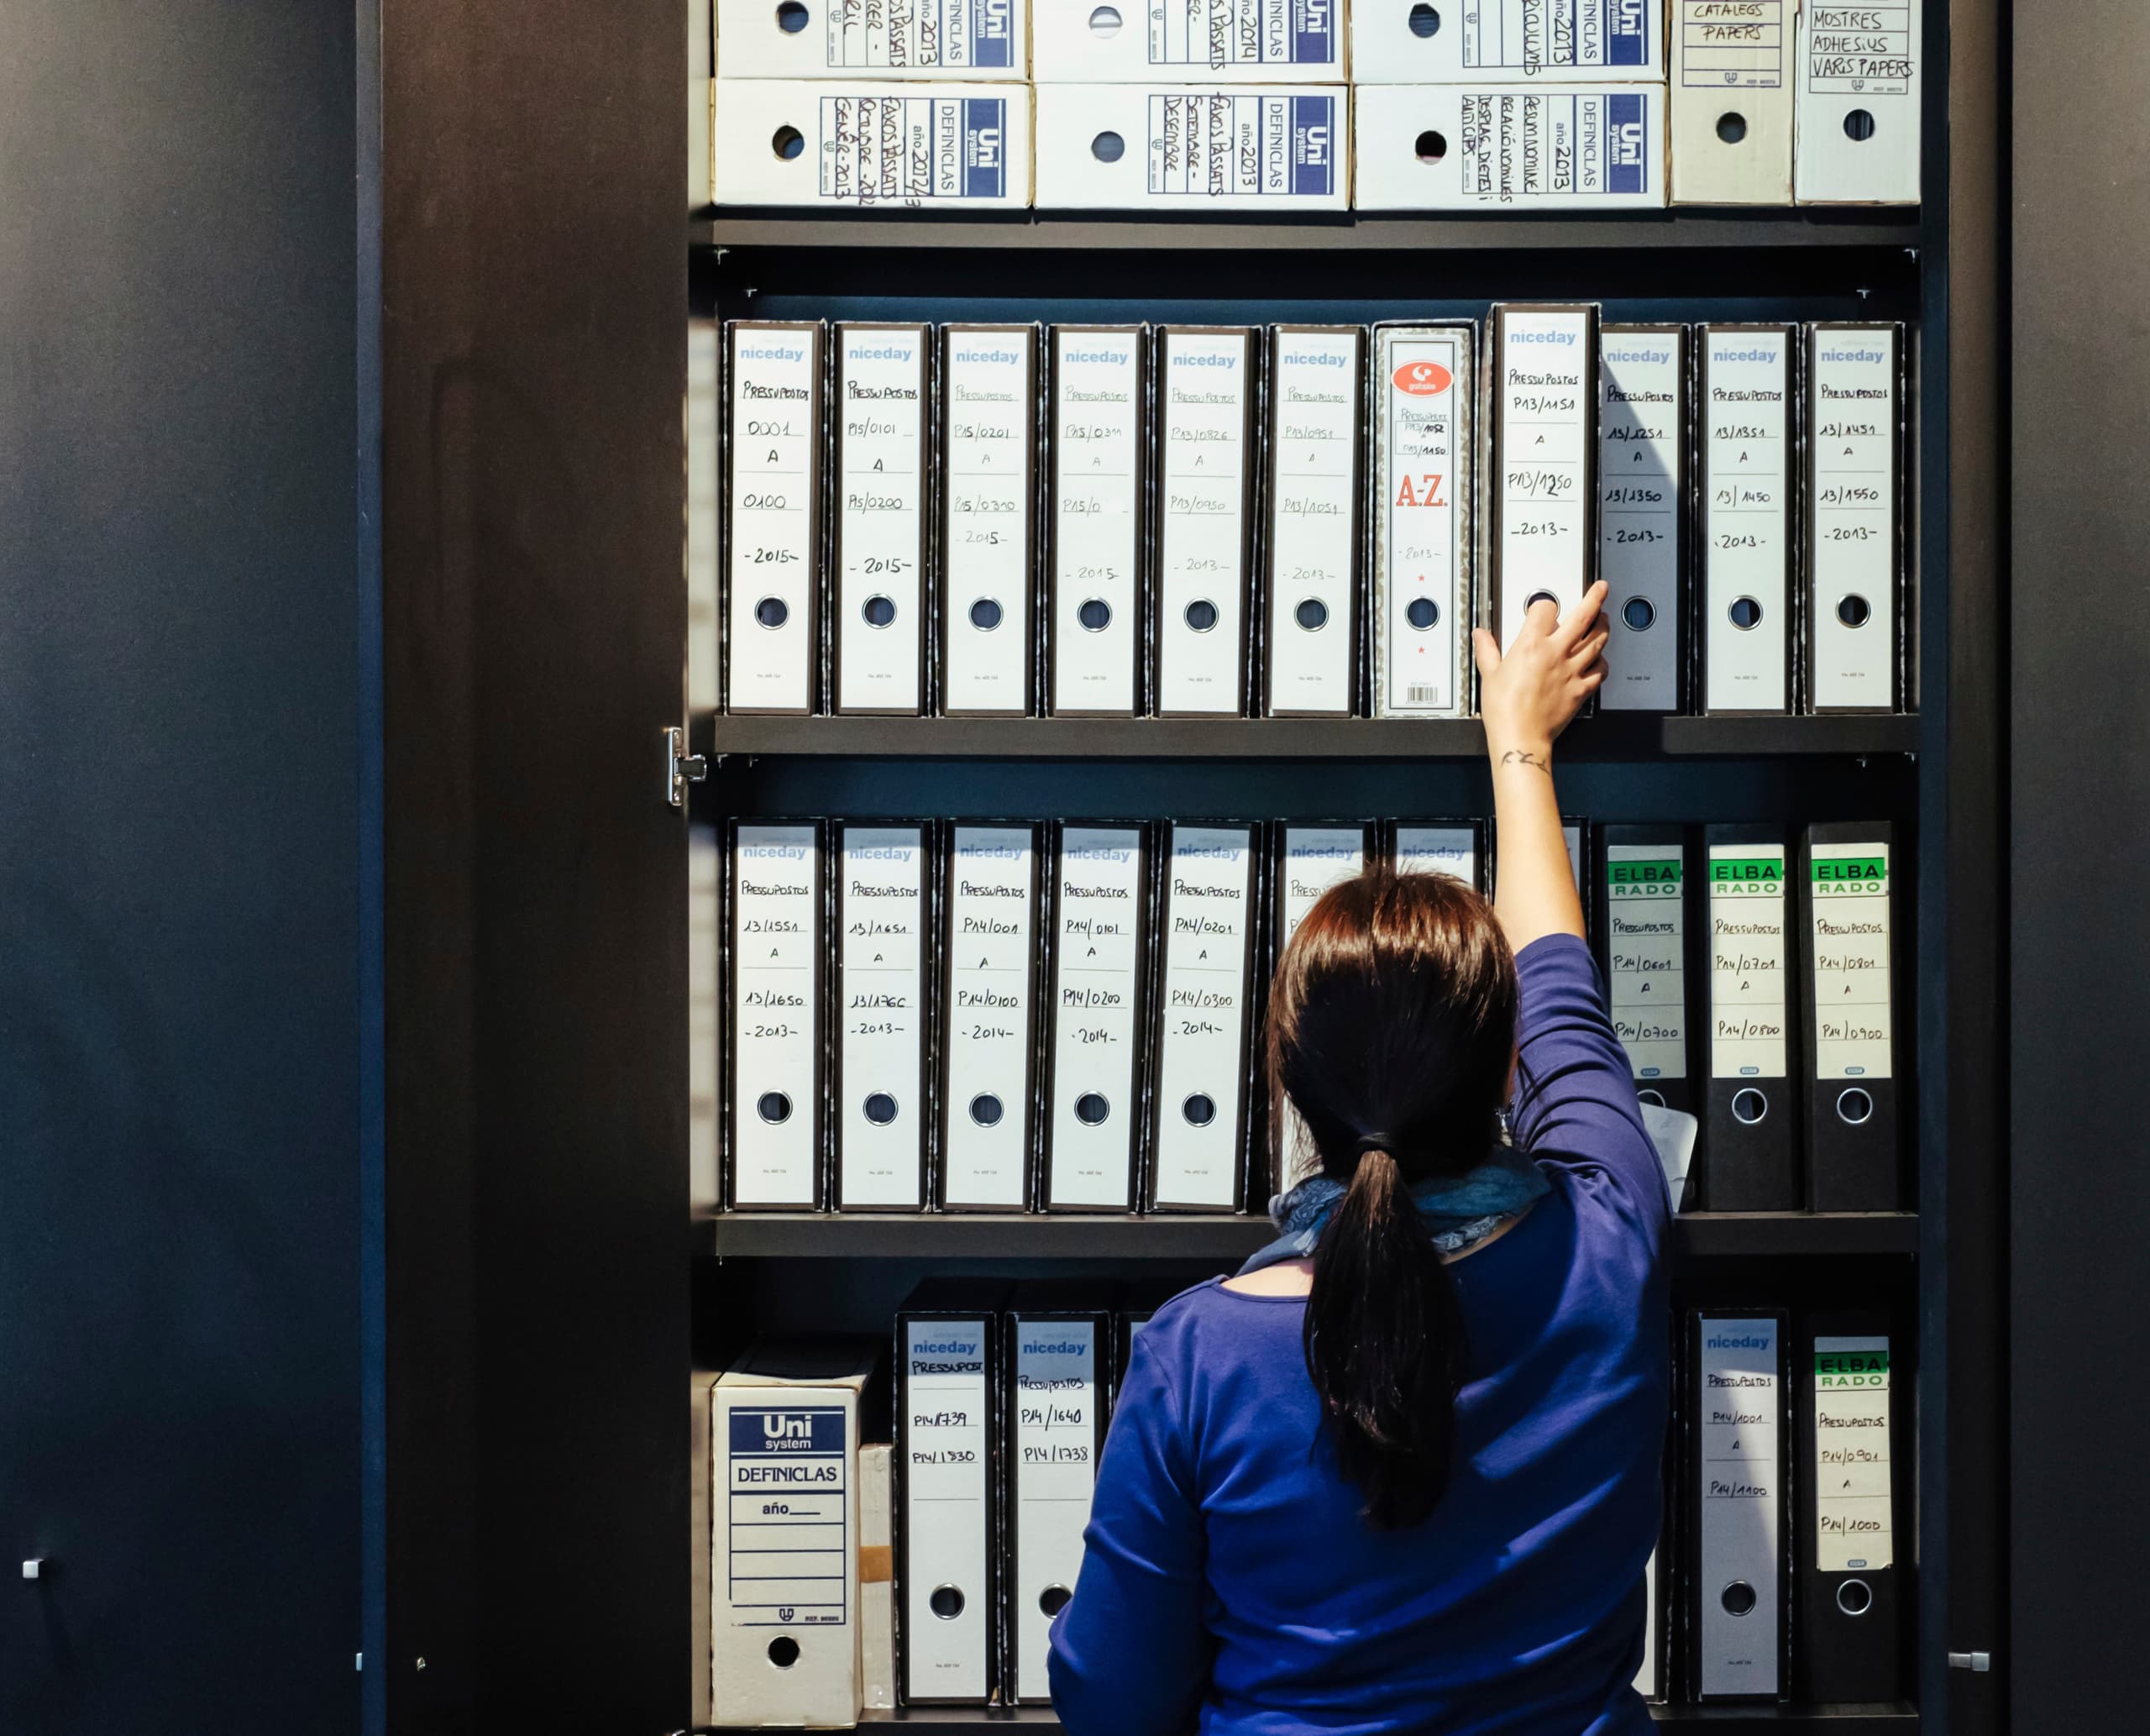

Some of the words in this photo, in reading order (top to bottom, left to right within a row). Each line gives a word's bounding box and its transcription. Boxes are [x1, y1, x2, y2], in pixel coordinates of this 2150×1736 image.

[1814, 11, 1883, 29] MOSTRES
[1241, 17, 1256, 58] 2014
[1701, 24, 1764, 40] PAPERS
[920, 20, 937, 65] 2013
[1554, 18, 1572, 64] 2013
[1859, 58, 1915, 77] PAPERS
[914, 125, 923, 149] año
[1242, 123, 1251, 145] año
[1555, 123, 1566, 145] año
[941, 106, 955, 190] DEFINICLAS
[968, 128, 978, 167] system
[978, 128, 999, 167] Uni
[1270, 103, 1282, 187] DEFINICLAS
[1297, 128, 1307, 164] system
[1308, 126, 1327, 165] Uni
[1584, 102, 1597, 186] DEFINICLAS
[1610, 125, 1620, 164] system
[1622, 123, 1641, 165] Uni
[1241, 146, 1256, 186] 2013
[1554, 145, 1571, 190] 2013
[1510, 329, 1576, 345] niceday
[740, 345, 804, 362] niceday
[849, 345, 912, 362] niceday
[956, 349, 1019, 365] niceday
[1065, 349, 1129, 365] niceday
[1173, 353, 1235, 369] niceday
[1284, 352, 1347, 368] niceday
[1607, 349, 1670, 365] niceday
[1713, 349, 1777, 365] niceday
[1821, 349, 1884, 365] niceday
[748, 421, 792, 436] 0001
[1535, 435, 1544, 444] A
[768, 449, 779, 464] A
[982, 454, 991, 464] A
[1633, 452, 1642, 462] A
[1739, 452, 1748, 463] A
[1843, 447, 1854, 456] A
[873, 459, 883, 473] A
[1092, 457, 1101, 466] A
[1195, 455, 1203, 466] A
[743, 494, 786, 509] 0100
[1606, 487, 1662, 503] 13/1350
[1820, 485, 1880, 505] 13/1550
[743, 844, 806, 861] niceday
[850, 844, 912, 862] niceday
[960, 843, 1022, 860] niceday
[1067, 845, 1130, 863] niceday
[1177, 843, 1240, 861] niceday
[1293, 844, 1355, 860] niceday
[1403, 847, 1466, 861] niceday
[1615, 867, 1675, 881] ELBA
[1716, 866, 1776, 879] ELBA
[1818, 865, 1879, 878] ELBA
[1615, 884, 1675, 895] RADO
[1717, 883, 1777, 893] RADO
[1819, 882, 1880, 893] RADO
[963, 917, 1019, 933] P14/001
[1175, 916, 1232, 935] P14/0201
[770, 948, 779, 958] A
[873, 953, 884, 962] A
[1087, 947, 1096, 957] A
[1199, 949, 1207, 960] A
[979, 957, 988, 968] A
[1613, 955, 1671, 973] P14/0601
[1717, 954, 1775, 975] P14/0701
[1641, 983, 1650, 992] A
[746, 990, 804, 1008] 13/1650
[1172, 989, 1232, 1008] P14/0300
[1615, 1021, 1678, 1041] P14/0700
[913, 1340, 977, 1356] niceday
[1023, 1340, 1087, 1356] niceday
[1707, 1336, 1770, 1351] niceday
[1821, 1358, 1881, 1372] ELBA
[1822, 1376, 1883, 1386] RADO
[1021, 1404, 1082, 1431] P14/1640
[1713, 1411, 1762, 1426] P14/1001
[763, 1414, 812, 1438] Uni
[765, 1439, 811, 1451] system
[1732, 1440, 1739, 1450] A
[1024, 1445, 1088, 1462] P14/1738
[737, 1466, 836, 1482] DEFINICLAS
[1711, 1482, 1767, 1497] P14/1100
